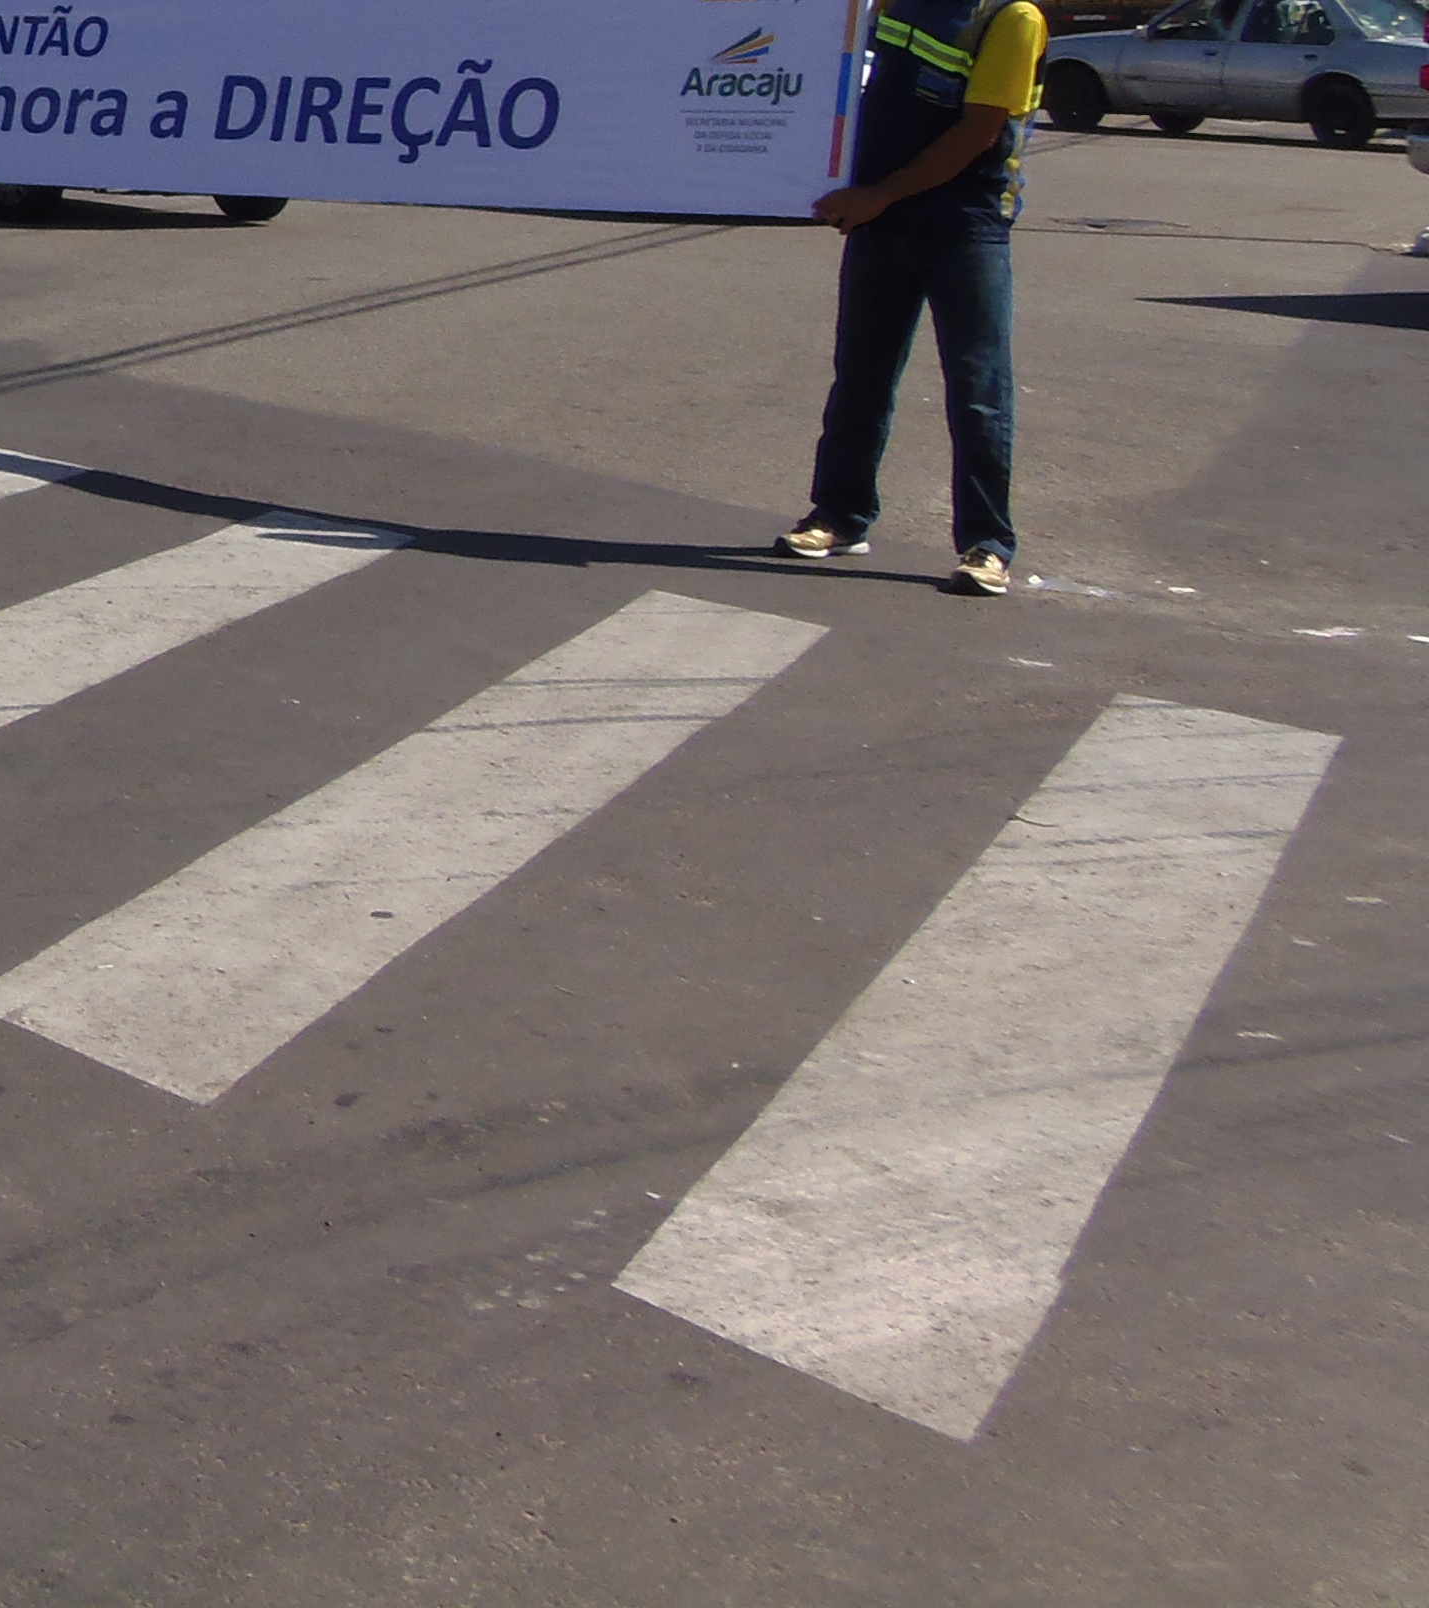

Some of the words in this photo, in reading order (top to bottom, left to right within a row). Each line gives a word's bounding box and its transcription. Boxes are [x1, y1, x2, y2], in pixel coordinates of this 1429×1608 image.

[149, 89, 190, 139] a
[213, 58, 561, 165] DIREÇÃO
[679, 66, 804, 106] Aracaju
